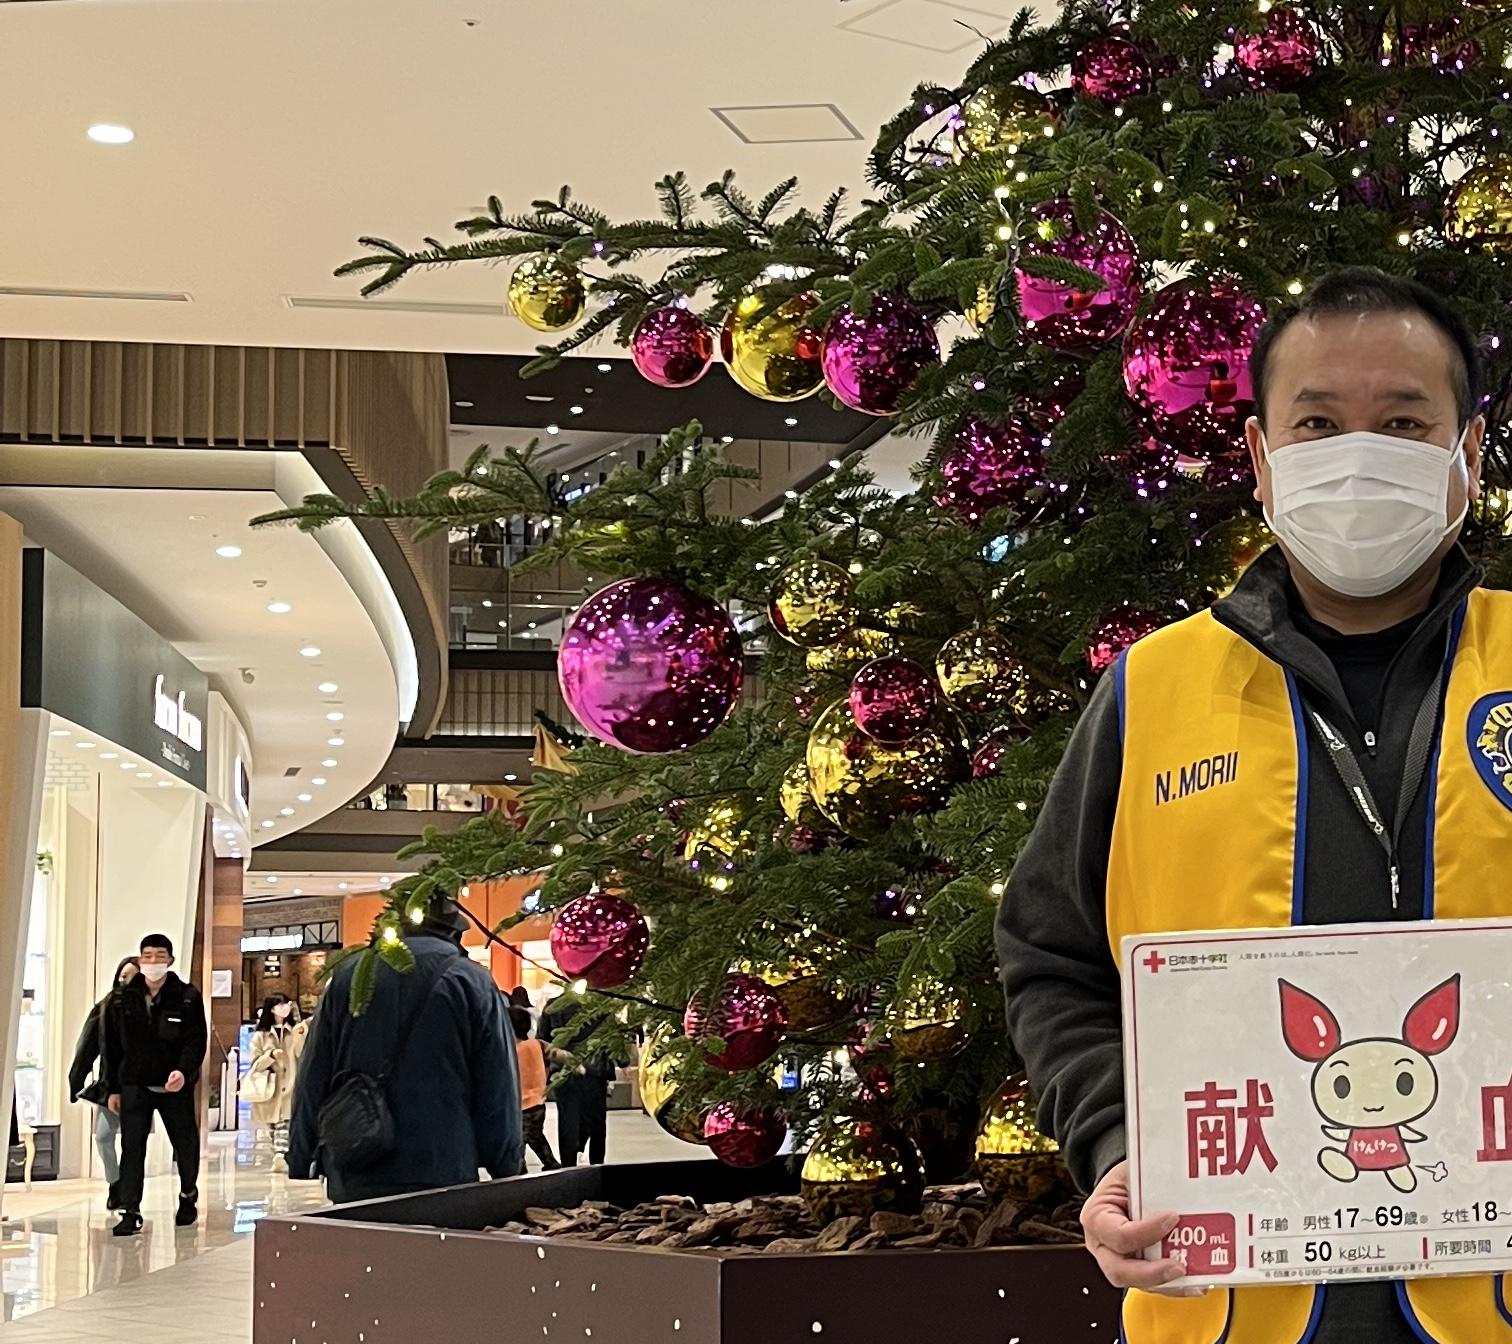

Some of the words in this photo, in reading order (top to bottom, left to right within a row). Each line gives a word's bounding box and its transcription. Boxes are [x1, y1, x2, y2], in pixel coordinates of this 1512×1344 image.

[1156, 751, 1239, 806] N.MORII
[1183, 1078, 1279, 1179] 献
[1353, 1139, 1398, 1154] けんけつ
[1260, 1216, 1289, 1232] 年齢
[1168, 1226, 1207, 1246] 400
[1210, 1233, 1230, 1244] mL
[1210, 1247, 1229, 1265] 血
[1260, 1249, 1289, 1264] 体重
[1304, 1241, 1332, 1262] 50
[1434, 1239, 1492, 1256] 所要時間
